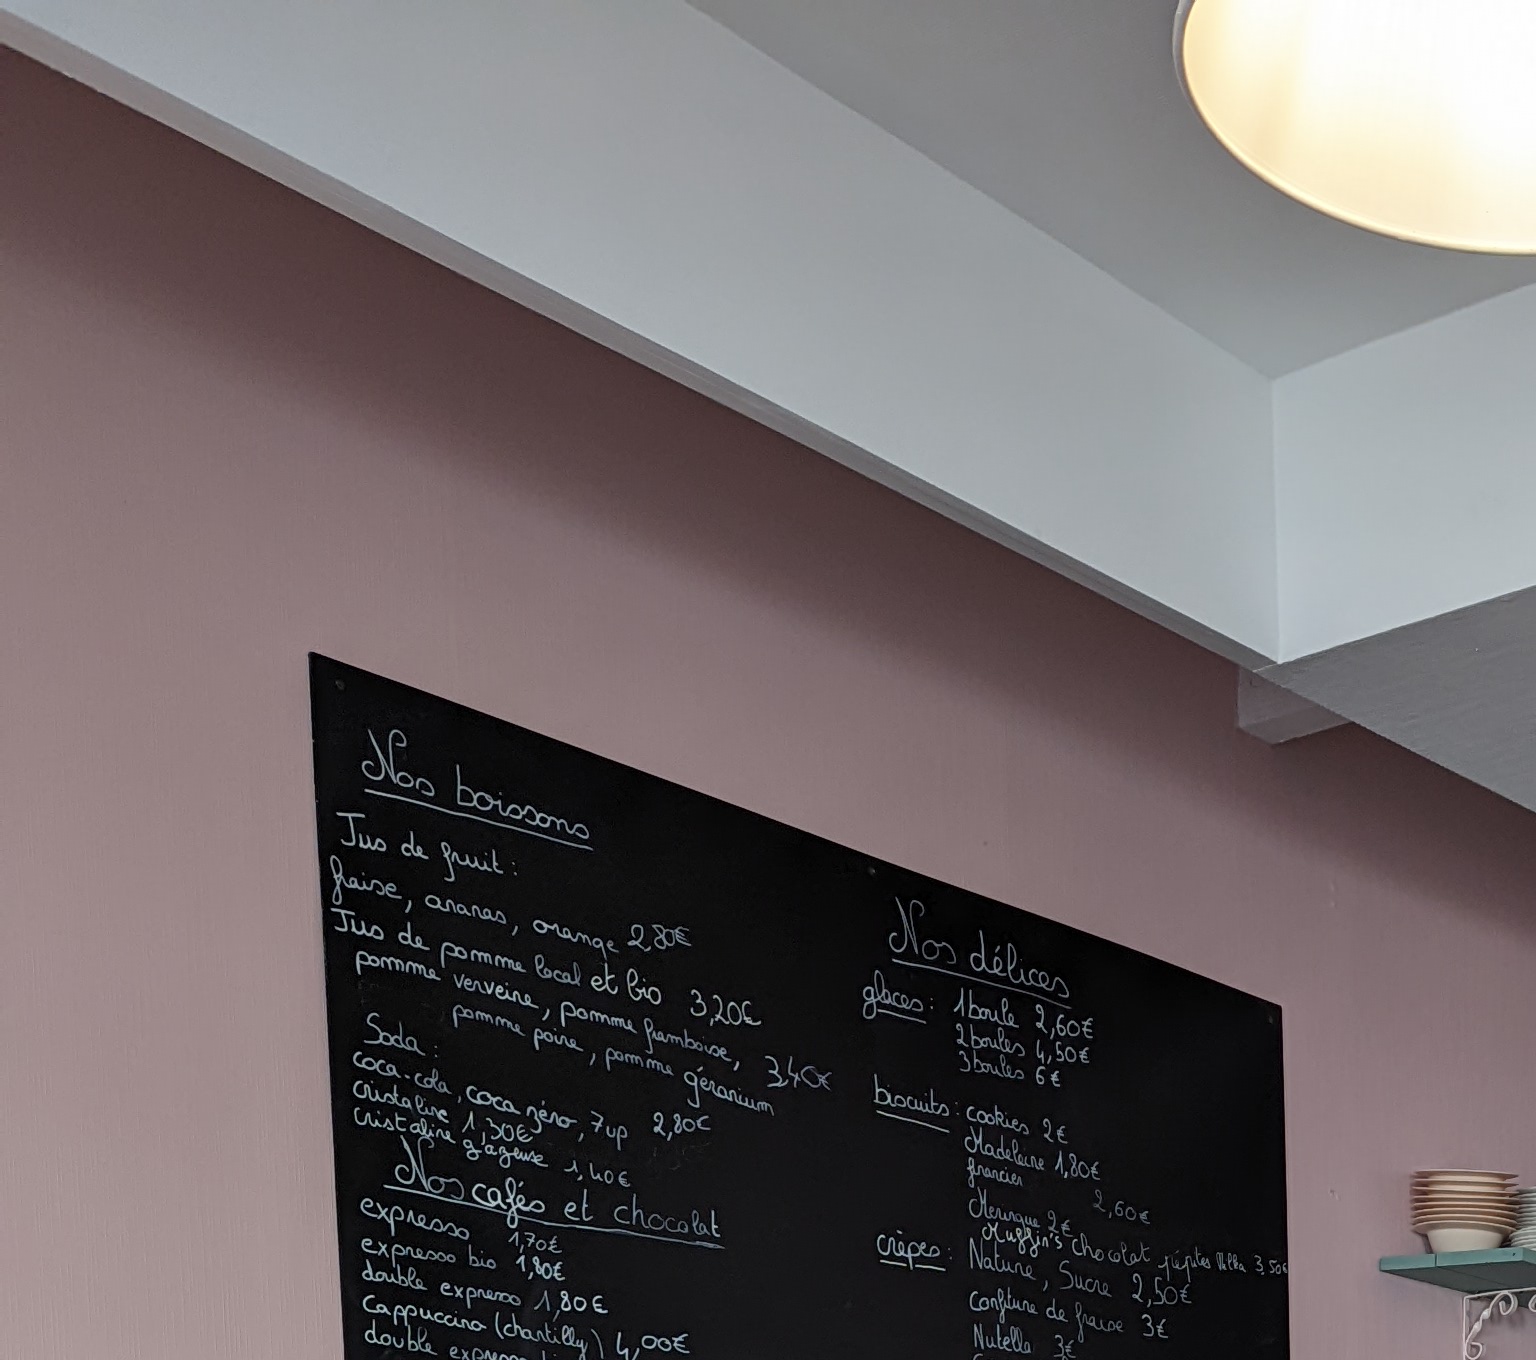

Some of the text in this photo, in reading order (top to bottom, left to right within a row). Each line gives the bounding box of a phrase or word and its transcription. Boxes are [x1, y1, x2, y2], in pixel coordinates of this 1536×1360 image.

[362, 729, 589, 839] Nos boissons
[336, 812, 428, 859] Jus de
[533, 920, 619, 960] orange
[888, 896, 1070, 999] Nos délices
[330, 908, 762, 1026] Jus de pomme local et bio 3,20€
[356, 951, 441, 980] pomme
[560, 1001, 637, 1034] pomme
[1035, 1003, 1094, 1040] 2,60€
[453, 1005, 526, 1037] pomme
[606, 1047, 674, 1076] pomme
[684, 1066, 775, 1116] géranium
[1036, 1039, 1090, 1065] 4,50€
[653, 1111, 711, 1142] 2,80€
[966, 1104, 1030, 1135] cookies
[964, 1126, 1101, 1181] Madeleine 1,80€
[395, 1135, 721, 1237] Nos cafés et chocolat
[360, 1198, 563, 1254] expresso 1,70€
[361, 1238, 566, 1281] expresso bio 1,80€
[1071, 1234, 1151, 1271] chocolat
[362, 1260, 428, 1291] double
[440, 1281, 522, 1309] expresso
[1059, 1260, 1112, 1297] Sucre
[1132, 1272, 1192, 1308] 2,50€
[365, 1325, 438, 1355] double
[973, 1323, 1032, 1354] Nutella
[1045, 1303, 1069, 1323] de
[1076, 1302, 1124, 1343] fraise
